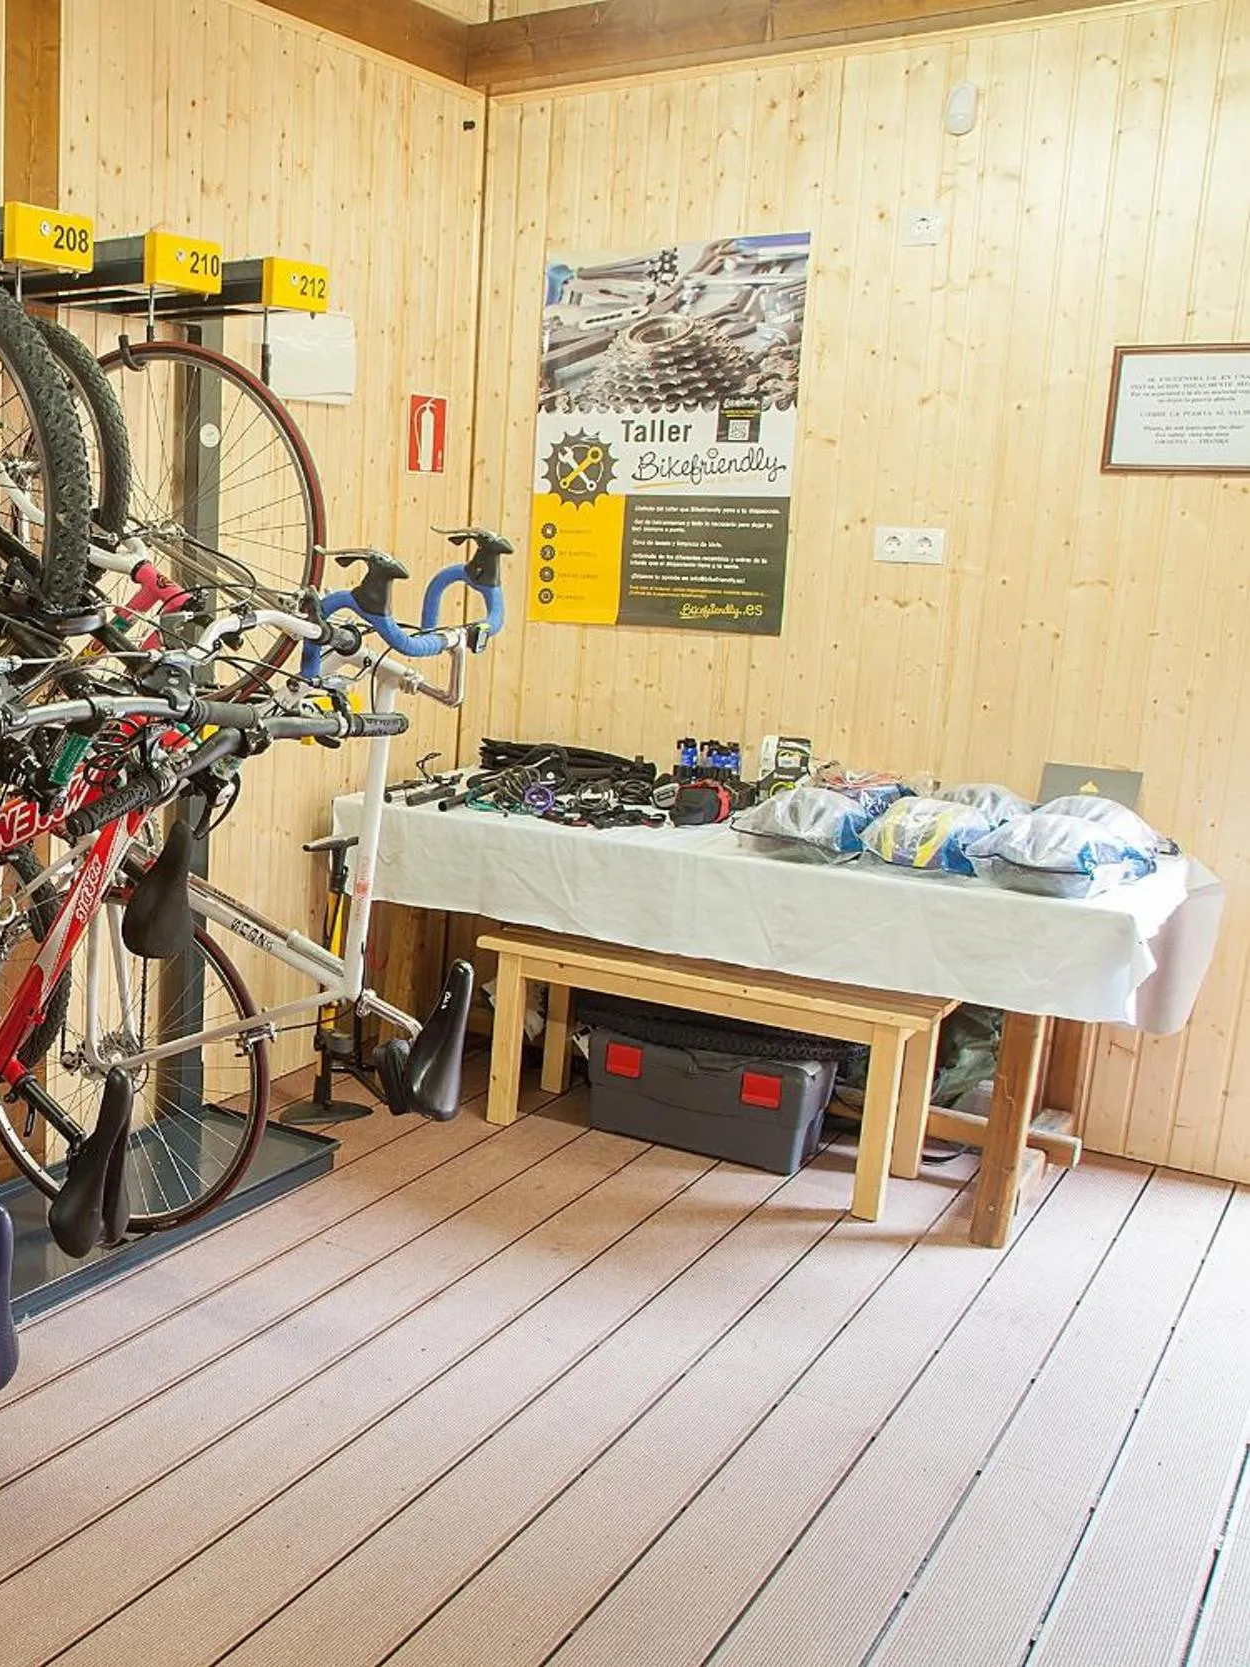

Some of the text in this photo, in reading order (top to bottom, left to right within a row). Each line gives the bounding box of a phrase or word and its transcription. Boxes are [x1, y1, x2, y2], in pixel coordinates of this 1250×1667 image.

[53, 224, 90, 254] 208
[189, 251, 221, 278] 210
[299, 274, 327, 299] 212
[621, 419, 692, 443] Taller
[631, 447, 787, 485] Bikefriendly
